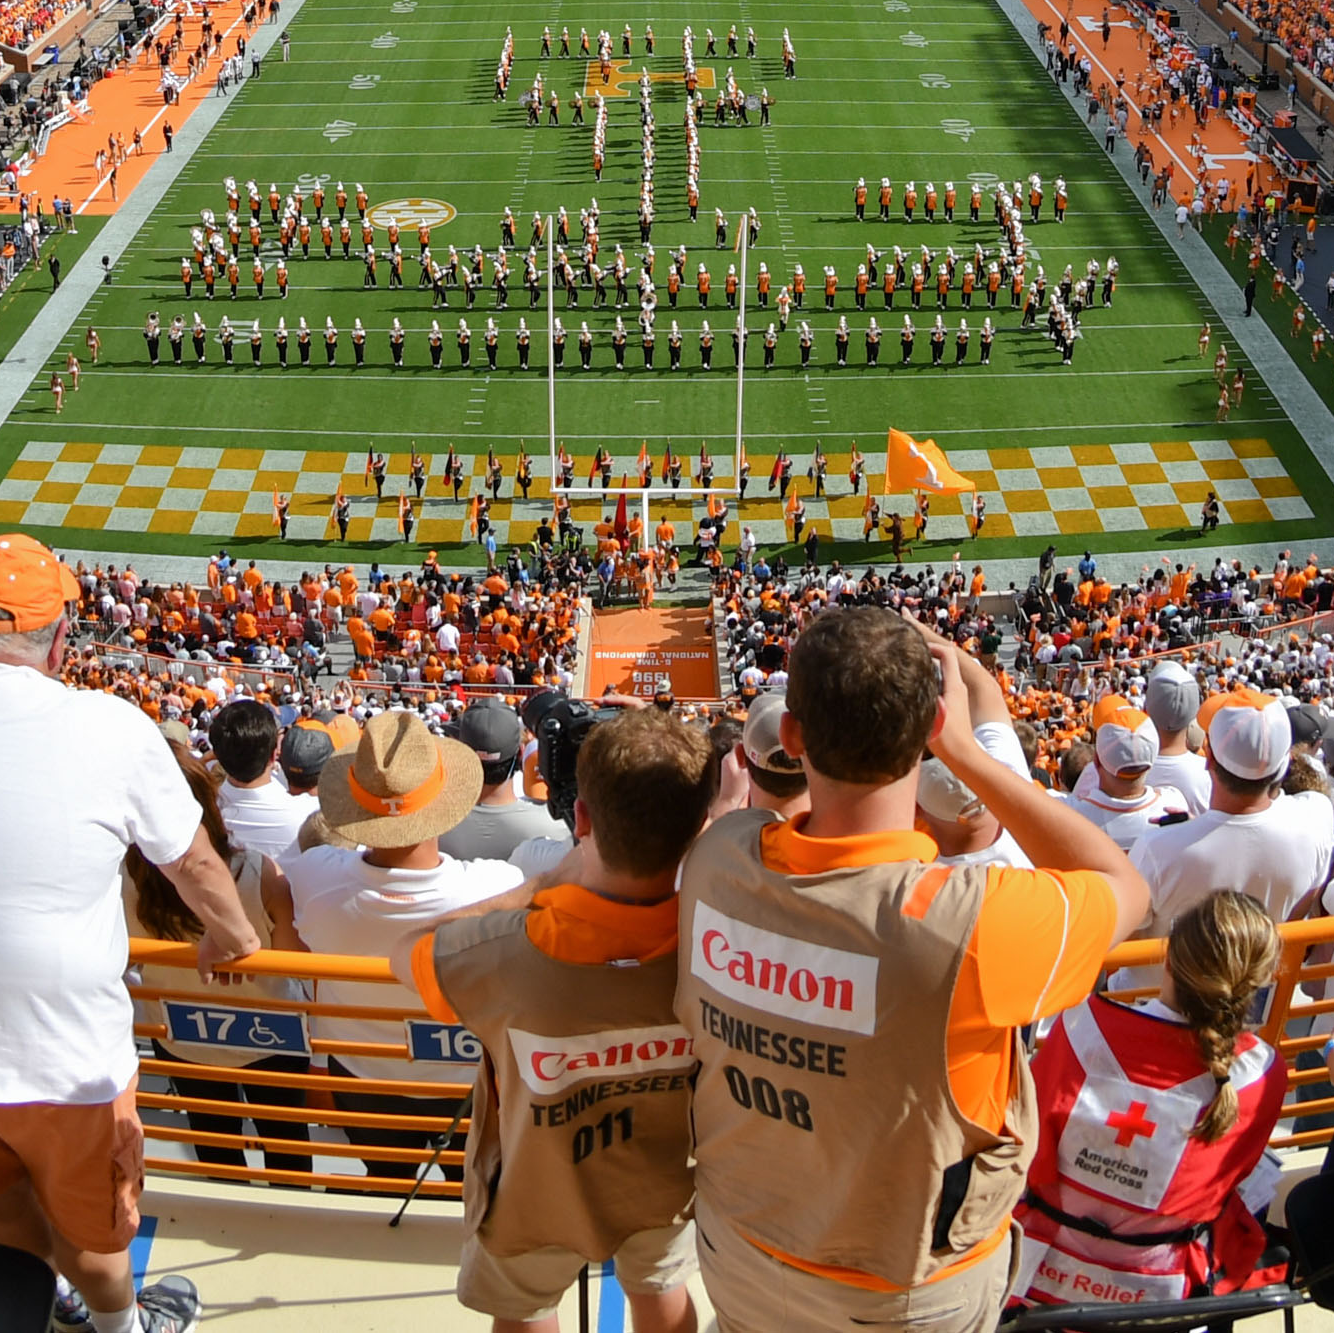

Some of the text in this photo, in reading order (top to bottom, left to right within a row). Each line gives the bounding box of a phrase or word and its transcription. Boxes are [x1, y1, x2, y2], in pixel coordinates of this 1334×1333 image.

[348, 74, 381, 90] 50
[919, 73, 952, 89] 50
[322, 119, 357, 138] 40
[940, 119, 976, 137] 40
[595, 651, 709, 659] NATIONAL CHAMPIONS
[381, 798, 404, 815] T
[701, 929, 854, 1012] Canon
[186, 1010, 236, 1041] 17
[699, 997, 847, 1078] TENNESSEE
[430, 1028, 482, 1058] 16
[531, 1037, 695, 1082] Canon
[530, 1074, 687, 1128] TENNESSEE
[723, 1065, 813, 1132] 008
[572, 1106, 634, 1166] 011
[1074, 1157, 1144, 1190] Red Cross
[1078, 1147, 1149, 1179] American
[1072, 1274, 1146, 1304] Relief
